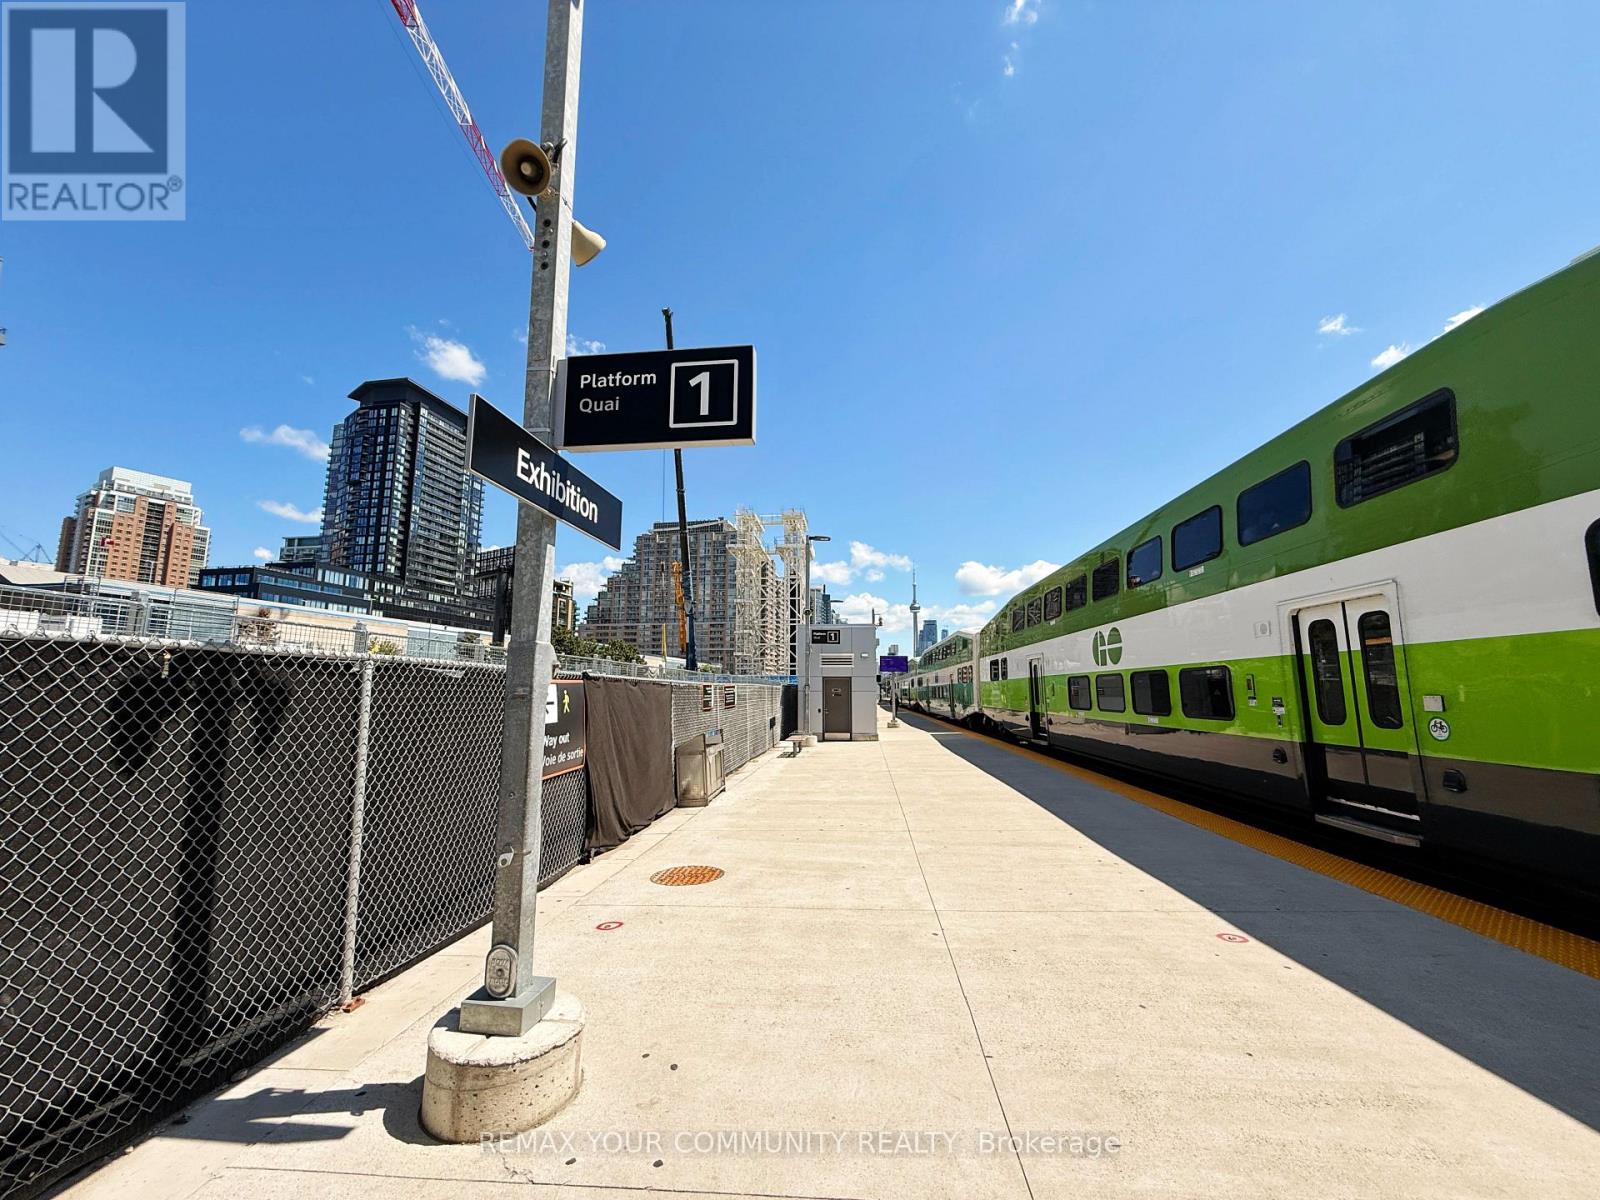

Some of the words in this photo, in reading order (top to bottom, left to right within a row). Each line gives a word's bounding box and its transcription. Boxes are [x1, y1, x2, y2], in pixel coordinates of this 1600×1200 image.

[579, 371, 657, 389] Platform
[688, 371, 711, 416] 1
[579, 396, 620, 413] Quai
[516, 447, 599, 524] Exhibition
[558, 732, 570, 744] out
[558, 751, 567, 764] de
[567, 746, 584, 760] sortie
